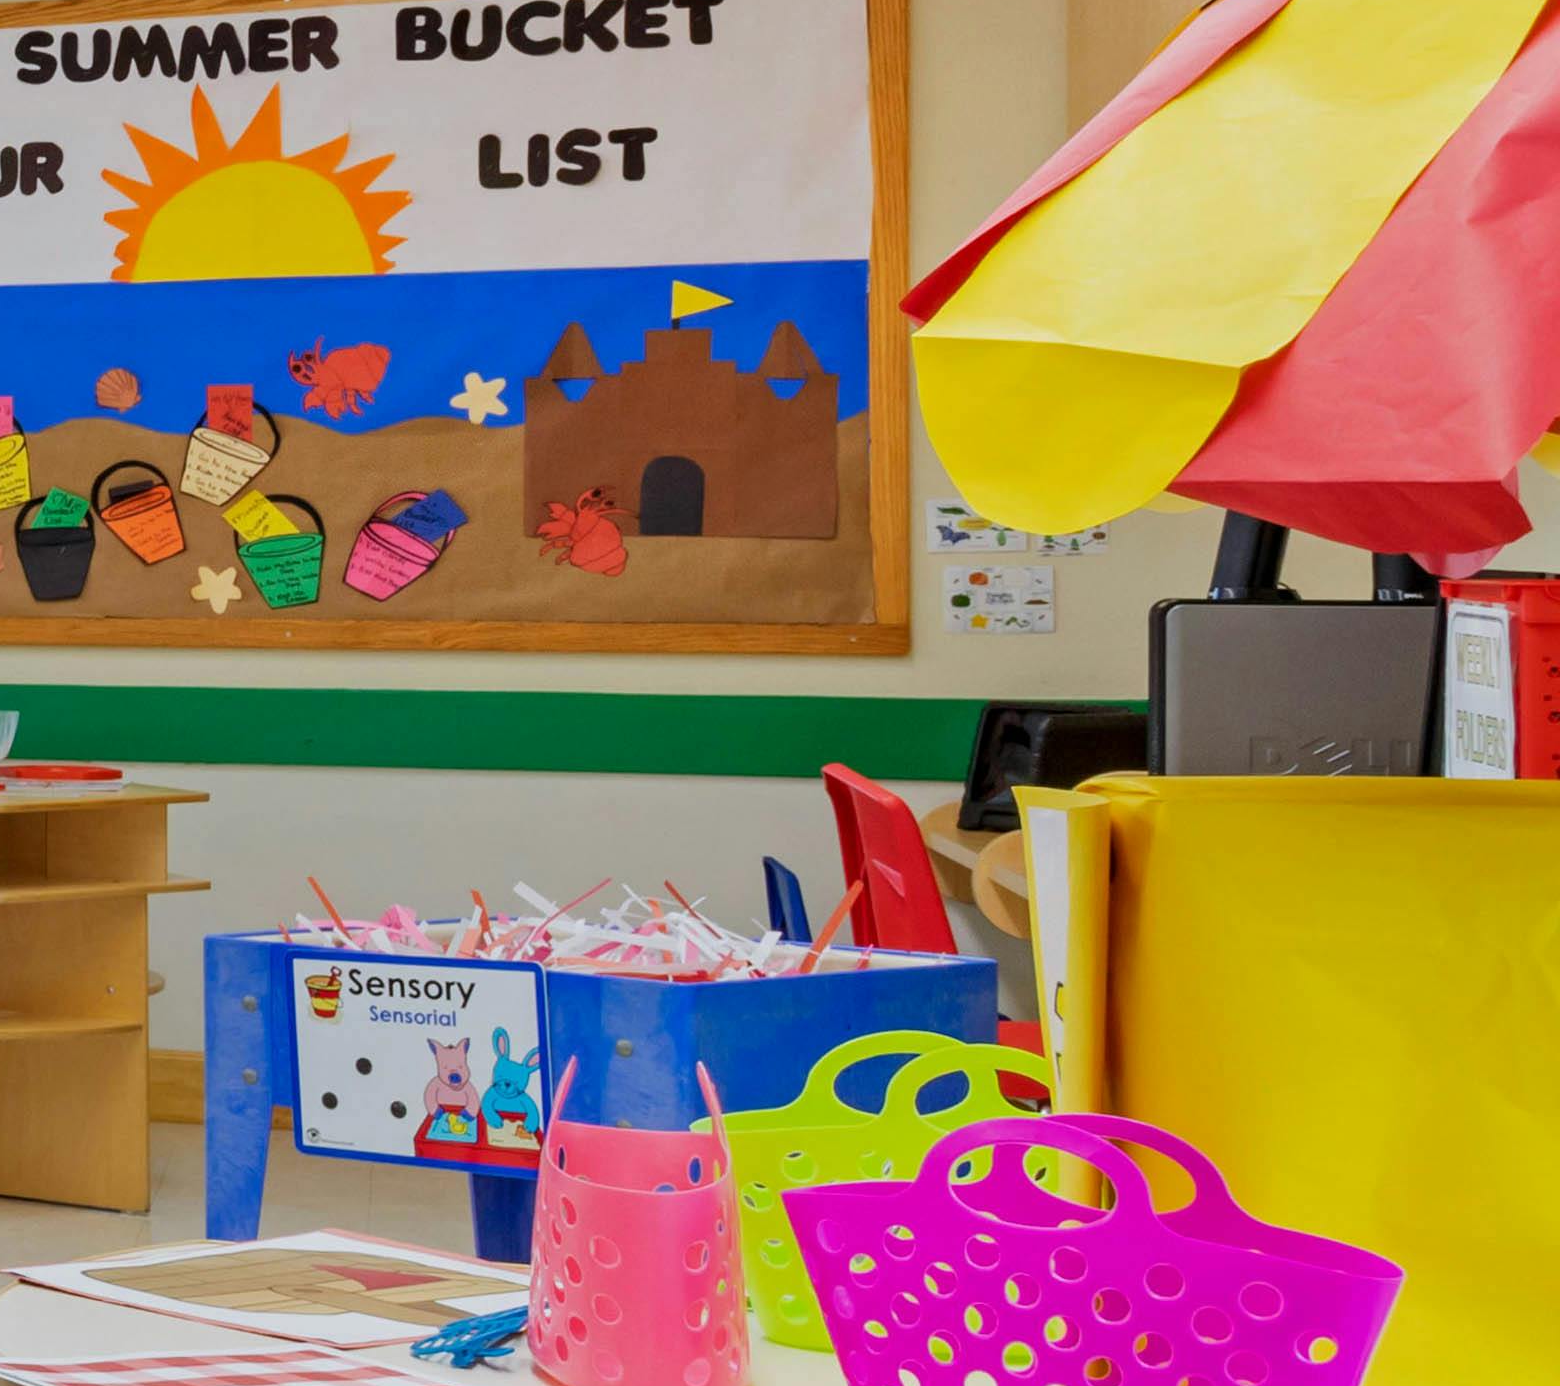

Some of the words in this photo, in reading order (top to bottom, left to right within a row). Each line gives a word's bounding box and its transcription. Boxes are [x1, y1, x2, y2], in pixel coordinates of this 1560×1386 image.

[13, 16, 341, 84] SUMMER
[477, 127, 659, 189] LIST
[348, 968, 476, 1008] Sensory
[369, 1004, 457, 1027] Sensorial
